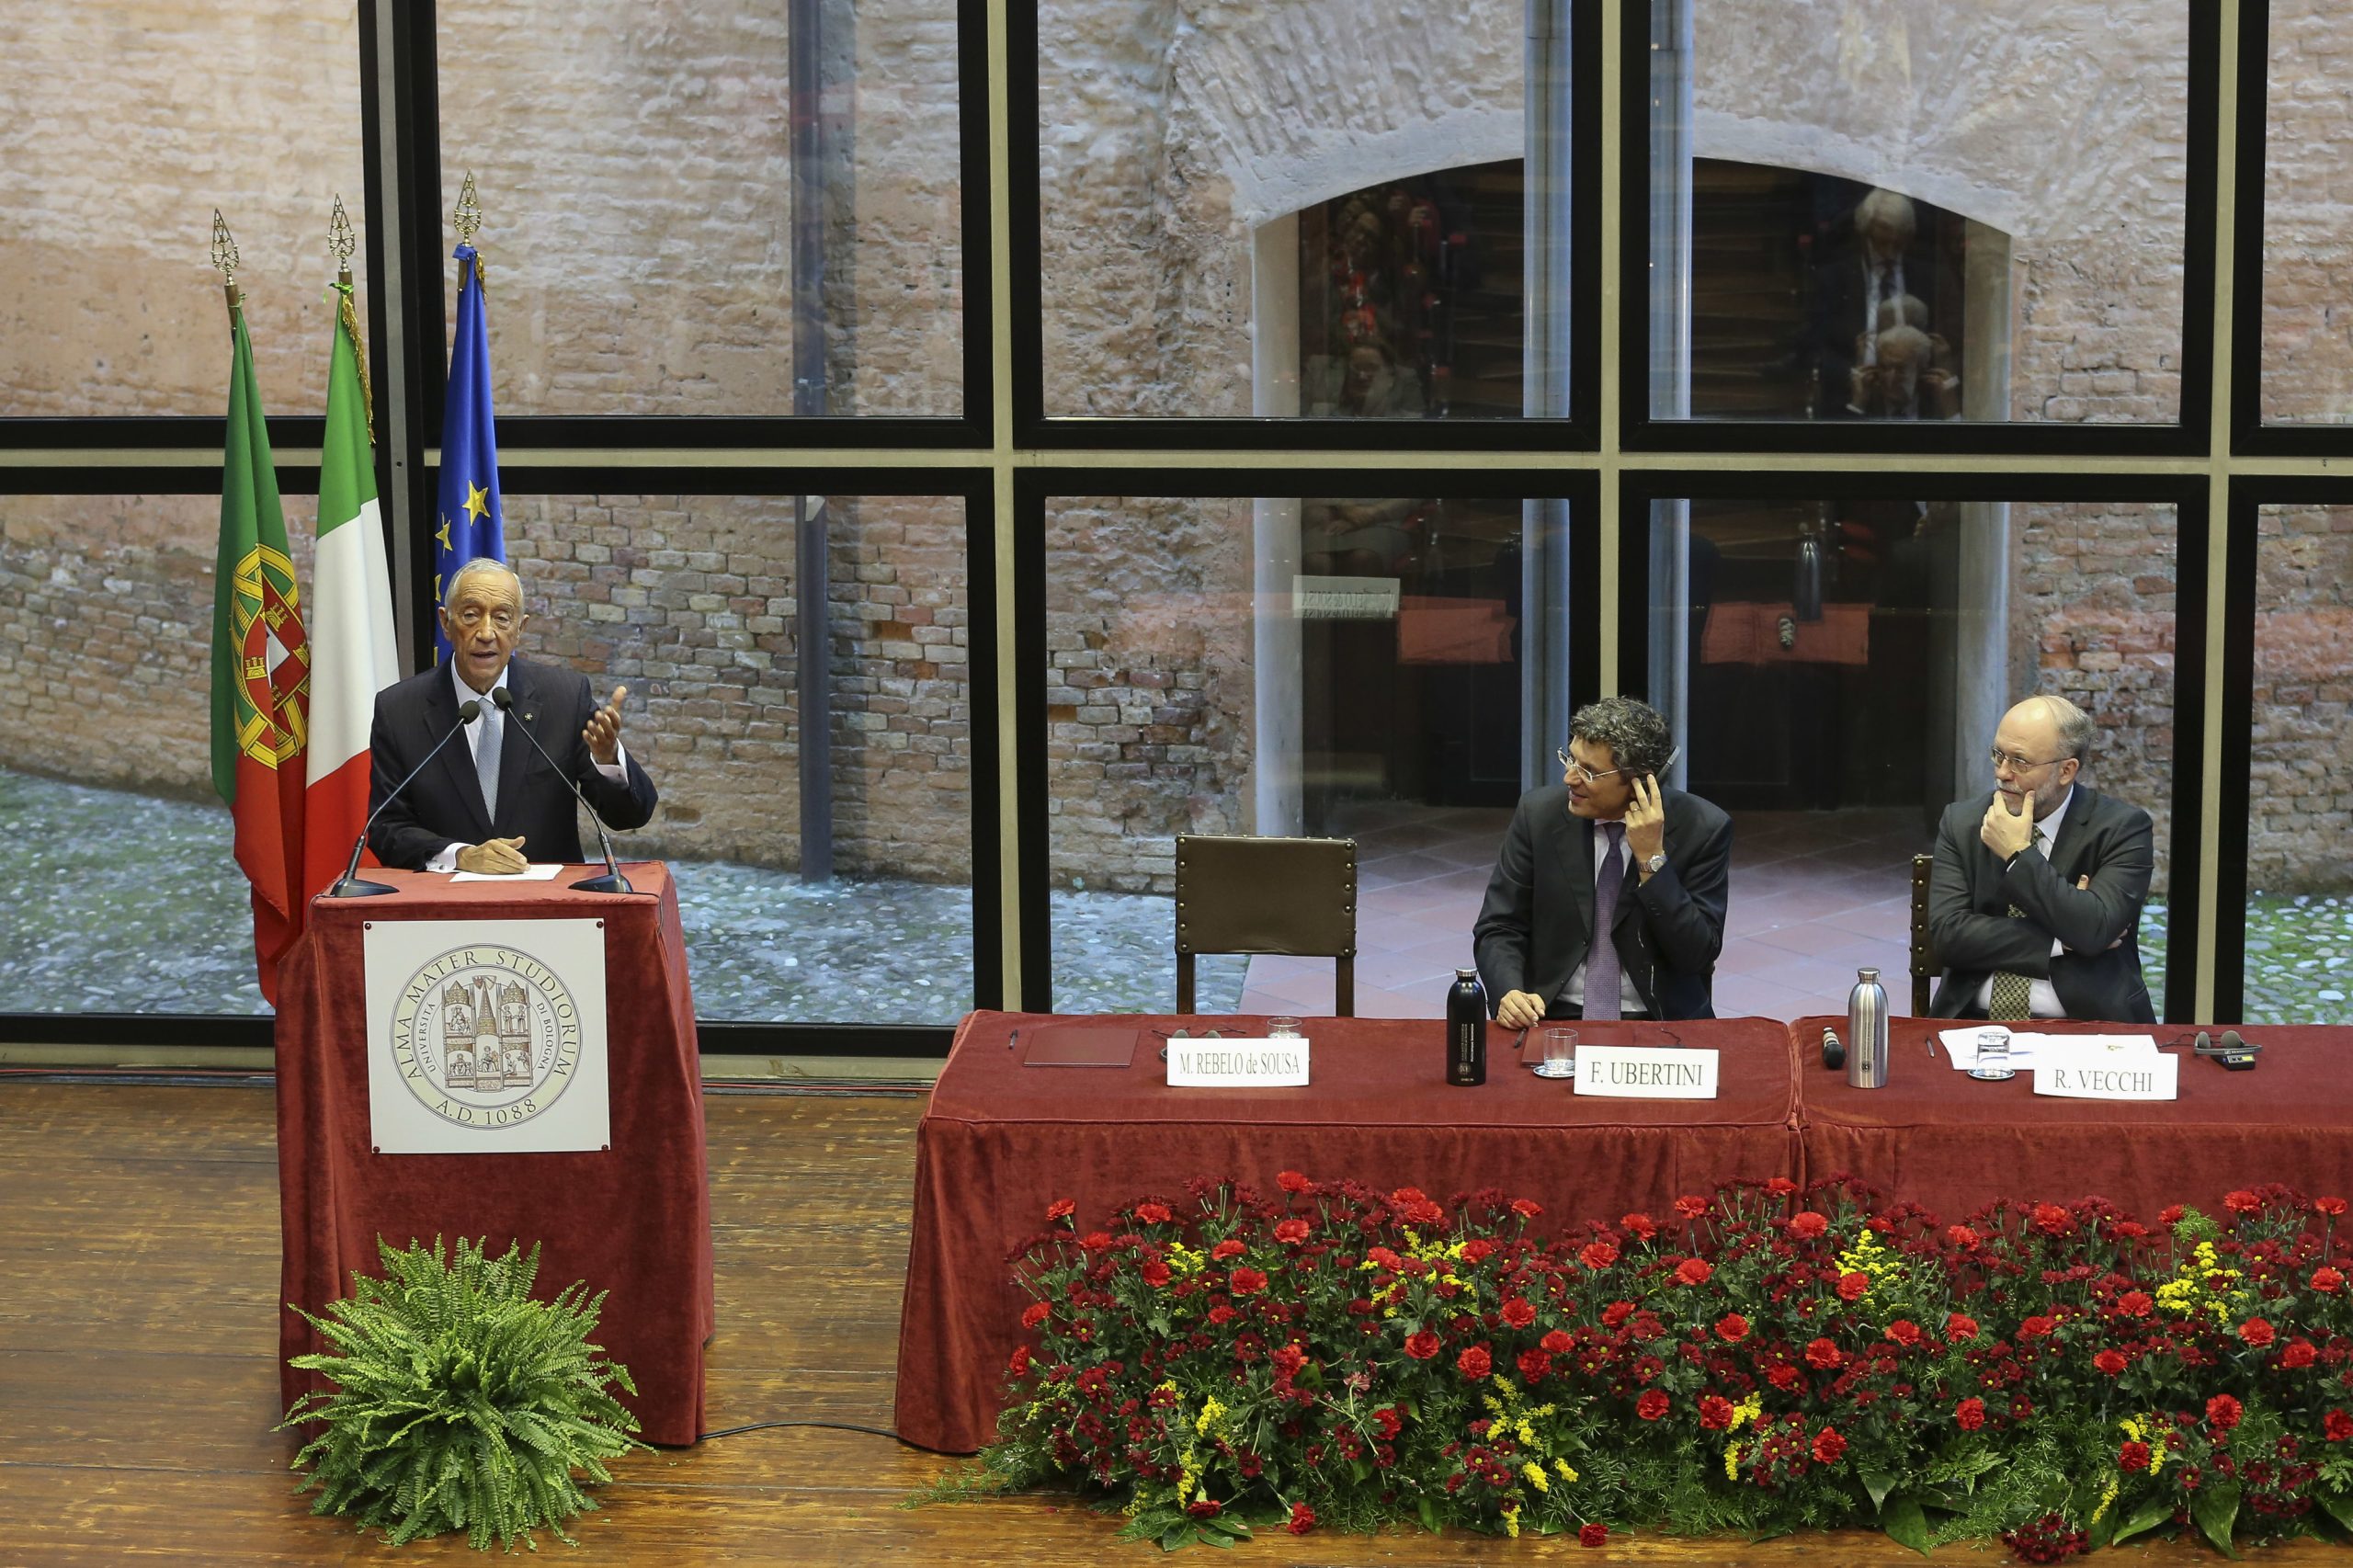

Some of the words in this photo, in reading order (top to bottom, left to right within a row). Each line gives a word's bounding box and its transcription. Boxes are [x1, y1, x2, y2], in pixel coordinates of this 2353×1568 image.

[406, 950, 479, 1005] MATER
[495, 950, 577, 1077] STUDIORUM
[536, 1002, 548, 1015] DI
[396, 1017, 422, 1080] ALMA
[537, 1018, 553, 1070] BOLOGNA
[1179, 1052, 1193, 1074] M.
[1197, 1052, 1244, 1074] REBELO
[1246, 1052, 1257, 1074] de
[1260, 1052, 1300, 1074] SOUSA
[1590, 1062, 1604, 1084] F.
[1610, 1062, 1703, 1085] UBERTINI
[2054, 1069, 2072, 1089] R.
[2078, 1070, 2153, 1092] VECCHI
[436, 1099, 475, 1124] A.D.
[485, 1098, 537, 1125] 1088
